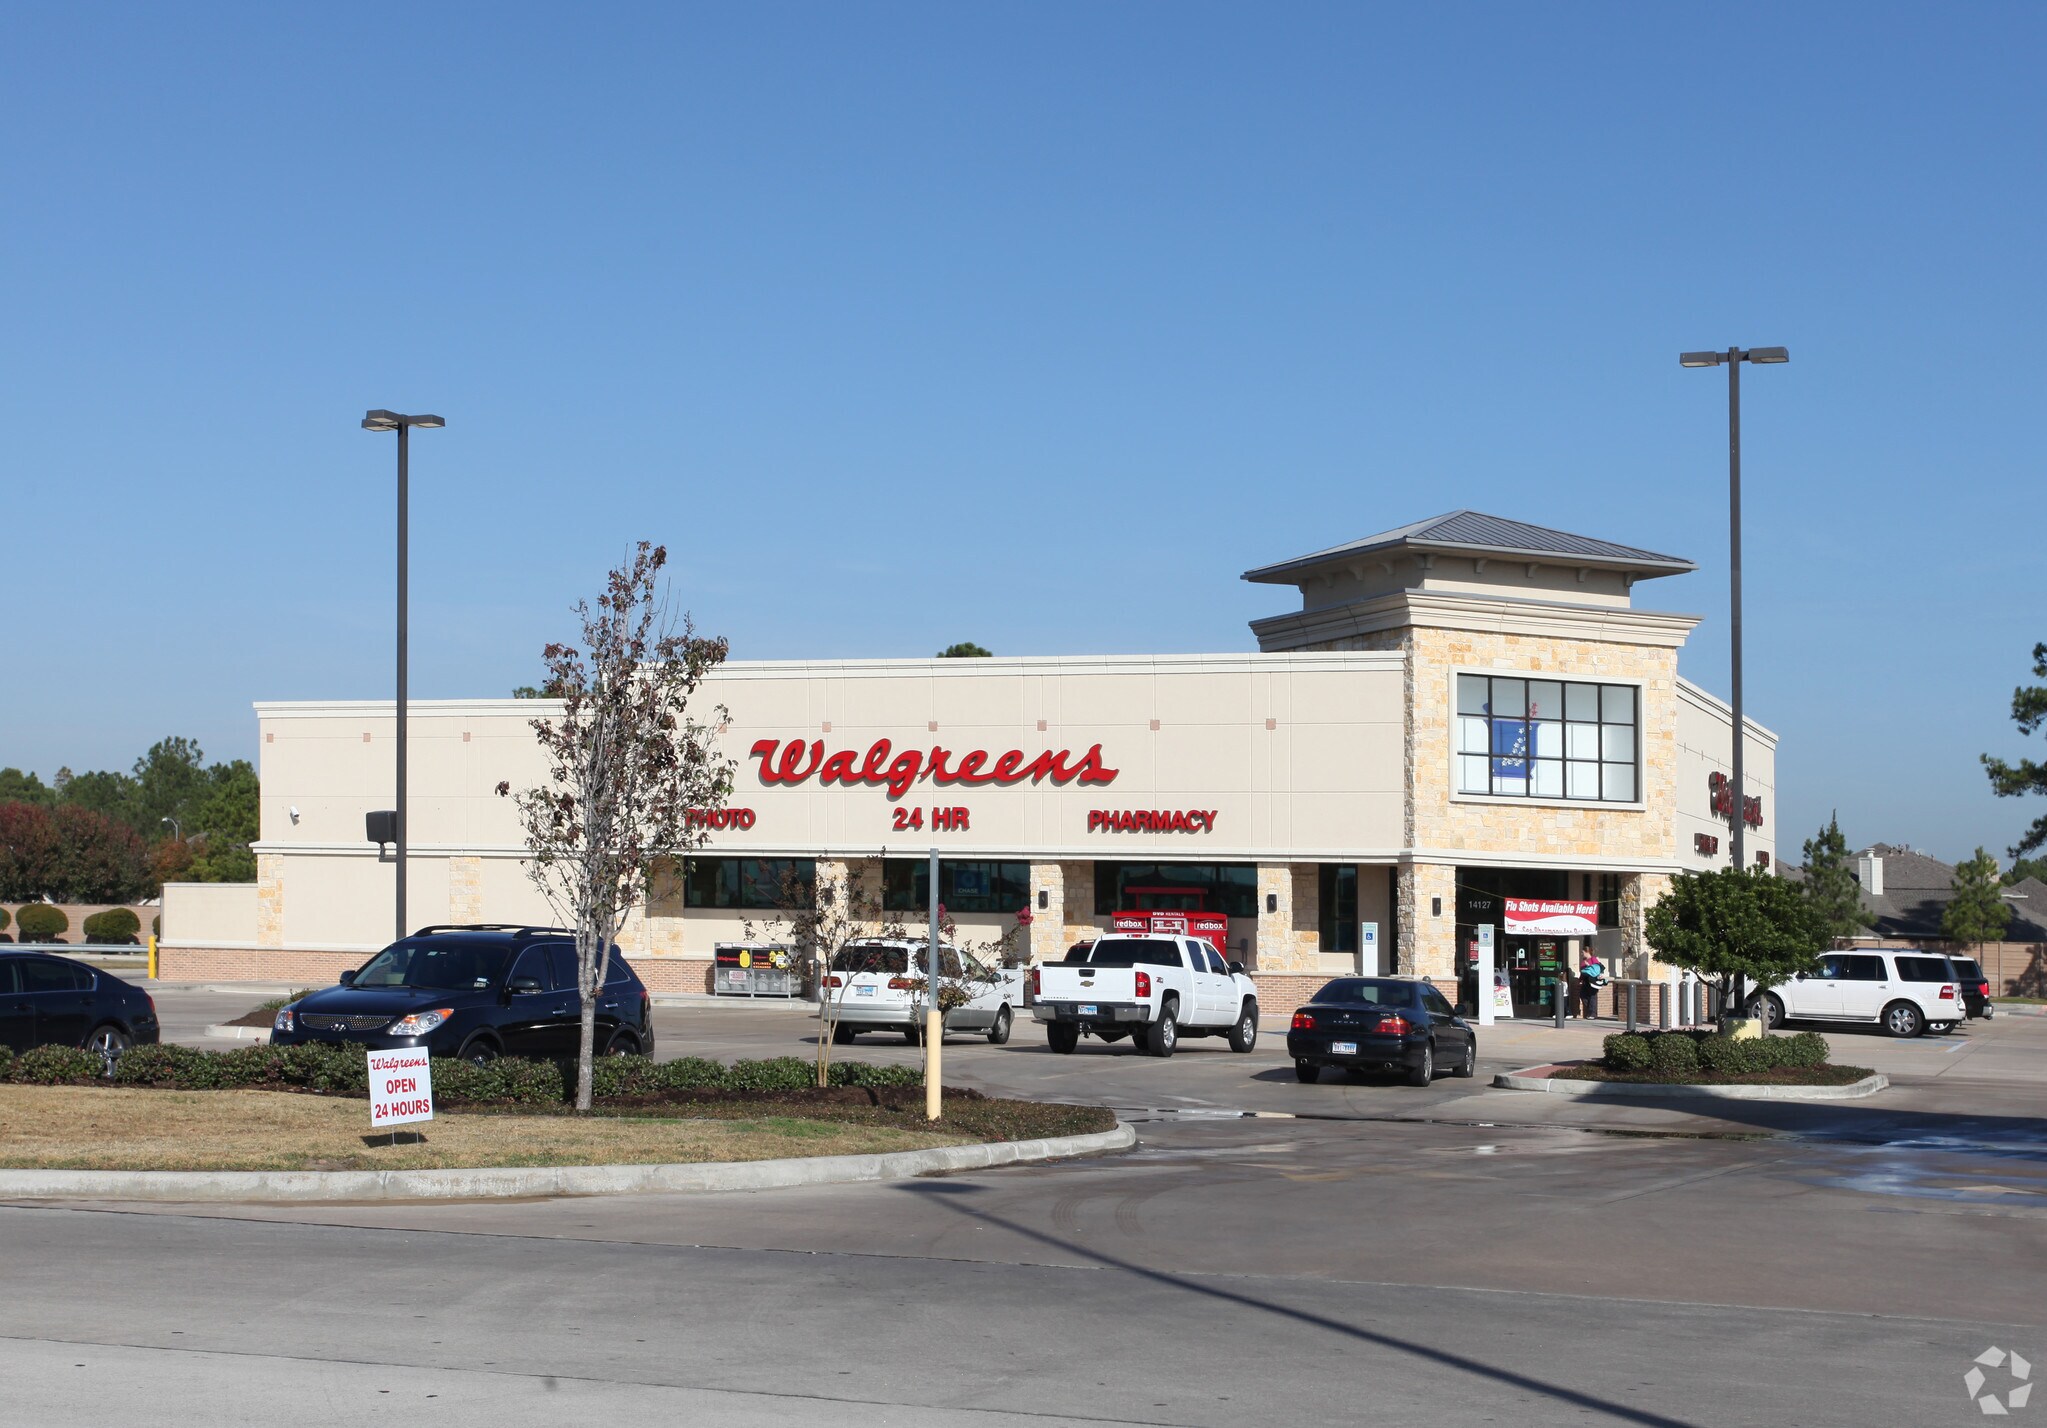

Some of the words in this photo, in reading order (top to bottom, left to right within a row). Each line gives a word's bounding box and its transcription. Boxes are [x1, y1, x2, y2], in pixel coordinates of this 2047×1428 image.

[749, 738, 1120, 800] Walgreens
[685, 808, 756, 831] PHOTO
[893, 807, 923, 831] 24
[932, 807, 970, 831] HR
[1088, 810, 1218, 834] PHARMACY
[1469, 901, 1491, 909] 14127
[1505, 900, 1518, 911] Flu
[1518, 901, 1540, 913] Shots
[1540, 903, 1575, 914] Available
[1575, 904, 1598, 914] Here!
[1116, 920, 1142, 928] redbox
[370, 1057, 428, 1073] Walgreens
[386, 1078, 417, 1094] OPEN
[375, 1103, 389, 1118] 24
[391, 1099, 430, 1116] HOURS
